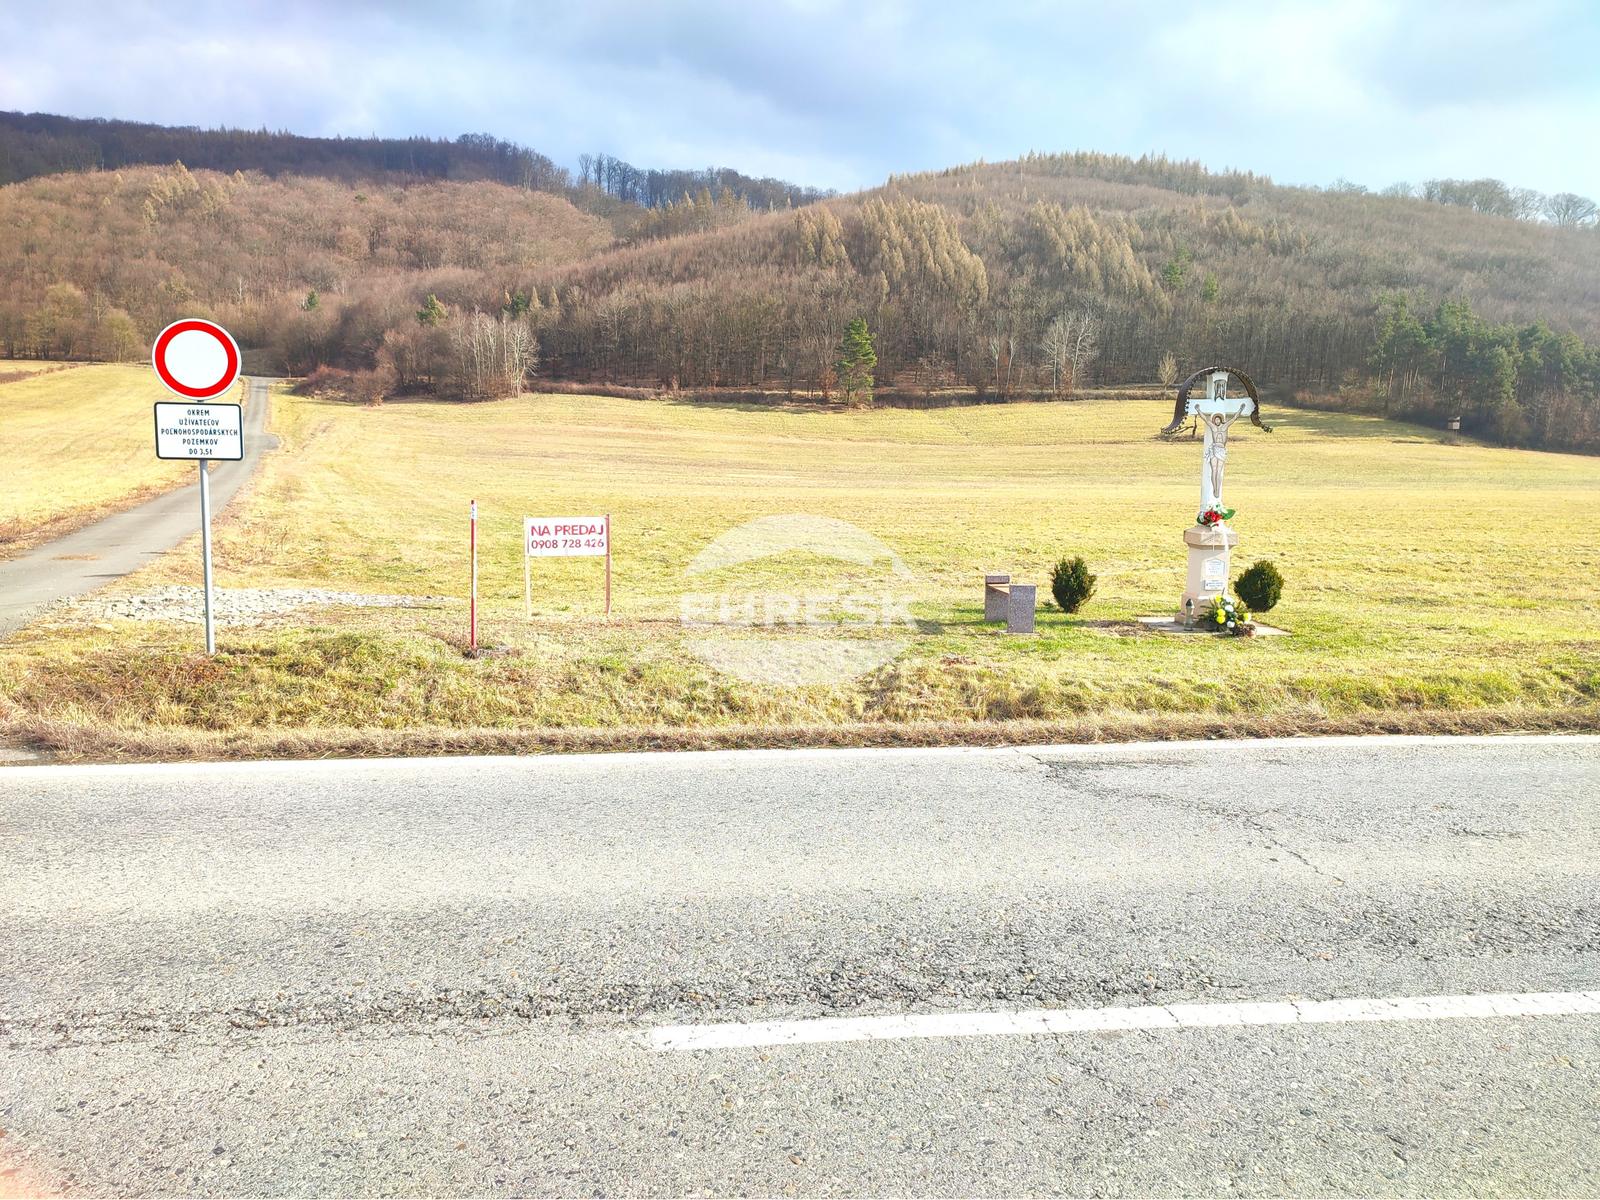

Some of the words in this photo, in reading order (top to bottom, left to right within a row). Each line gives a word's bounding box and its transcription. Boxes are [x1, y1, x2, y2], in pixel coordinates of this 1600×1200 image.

[179, 418, 219, 426] UŽÍVATEĽOV
[161, 427, 238, 436] POĽNOHOSPODÁRSKYCH
[531, 525, 550, 536] NA
[554, 524, 604, 536] PREDAJ
[531, 540, 558, 549] 0908
[562, 539, 582, 548] 728
[584, 538, 604, 548] 426
